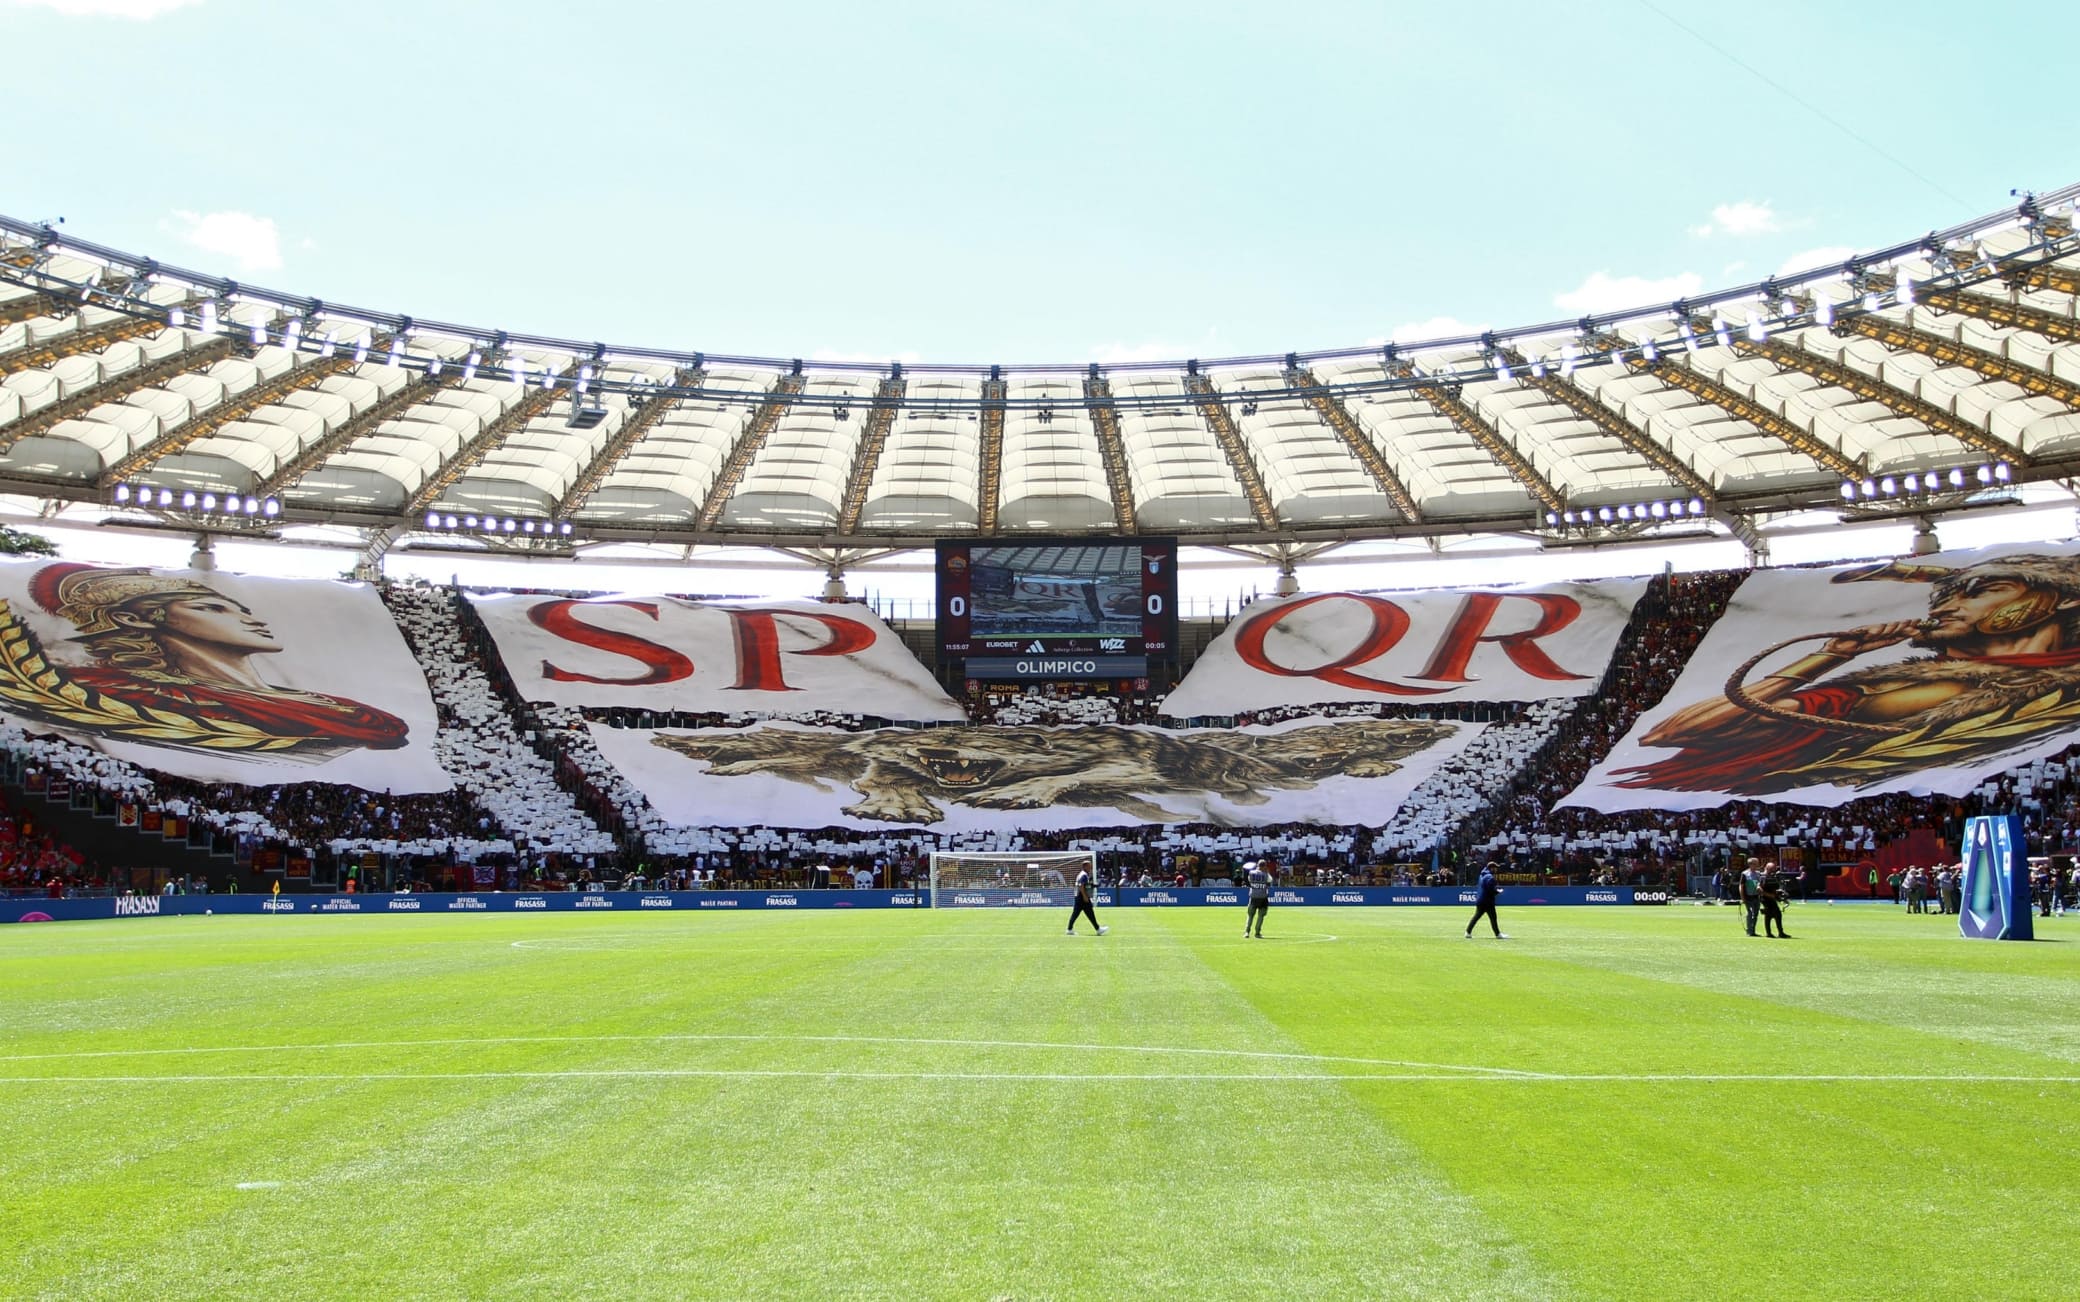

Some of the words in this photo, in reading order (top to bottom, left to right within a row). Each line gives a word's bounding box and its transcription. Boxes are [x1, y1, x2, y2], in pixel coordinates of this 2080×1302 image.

[950, 597, 965, 616] 0
[1147, 595, 1162, 615] 0
[1016, 661, 1096, 674] OLIMPICO
[990, 684, 1020, 692] ROMA
[954, 896, 985, 904] FRASASSI
[1206, 895, 1237, 903] FRASASSI
[1333, 894, 1364, 902] FRASASSI
[1586, 894, 1617, 902] FRASASSI
[1634, 891, 1666, 901] 00:00
[115, 896, 160, 914] FRASASSI
[389, 901, 420, 909] FRASASSI
[515, 900, 546, 908] FRASASSI
[641, 899, 672, 907] FRASASSI
